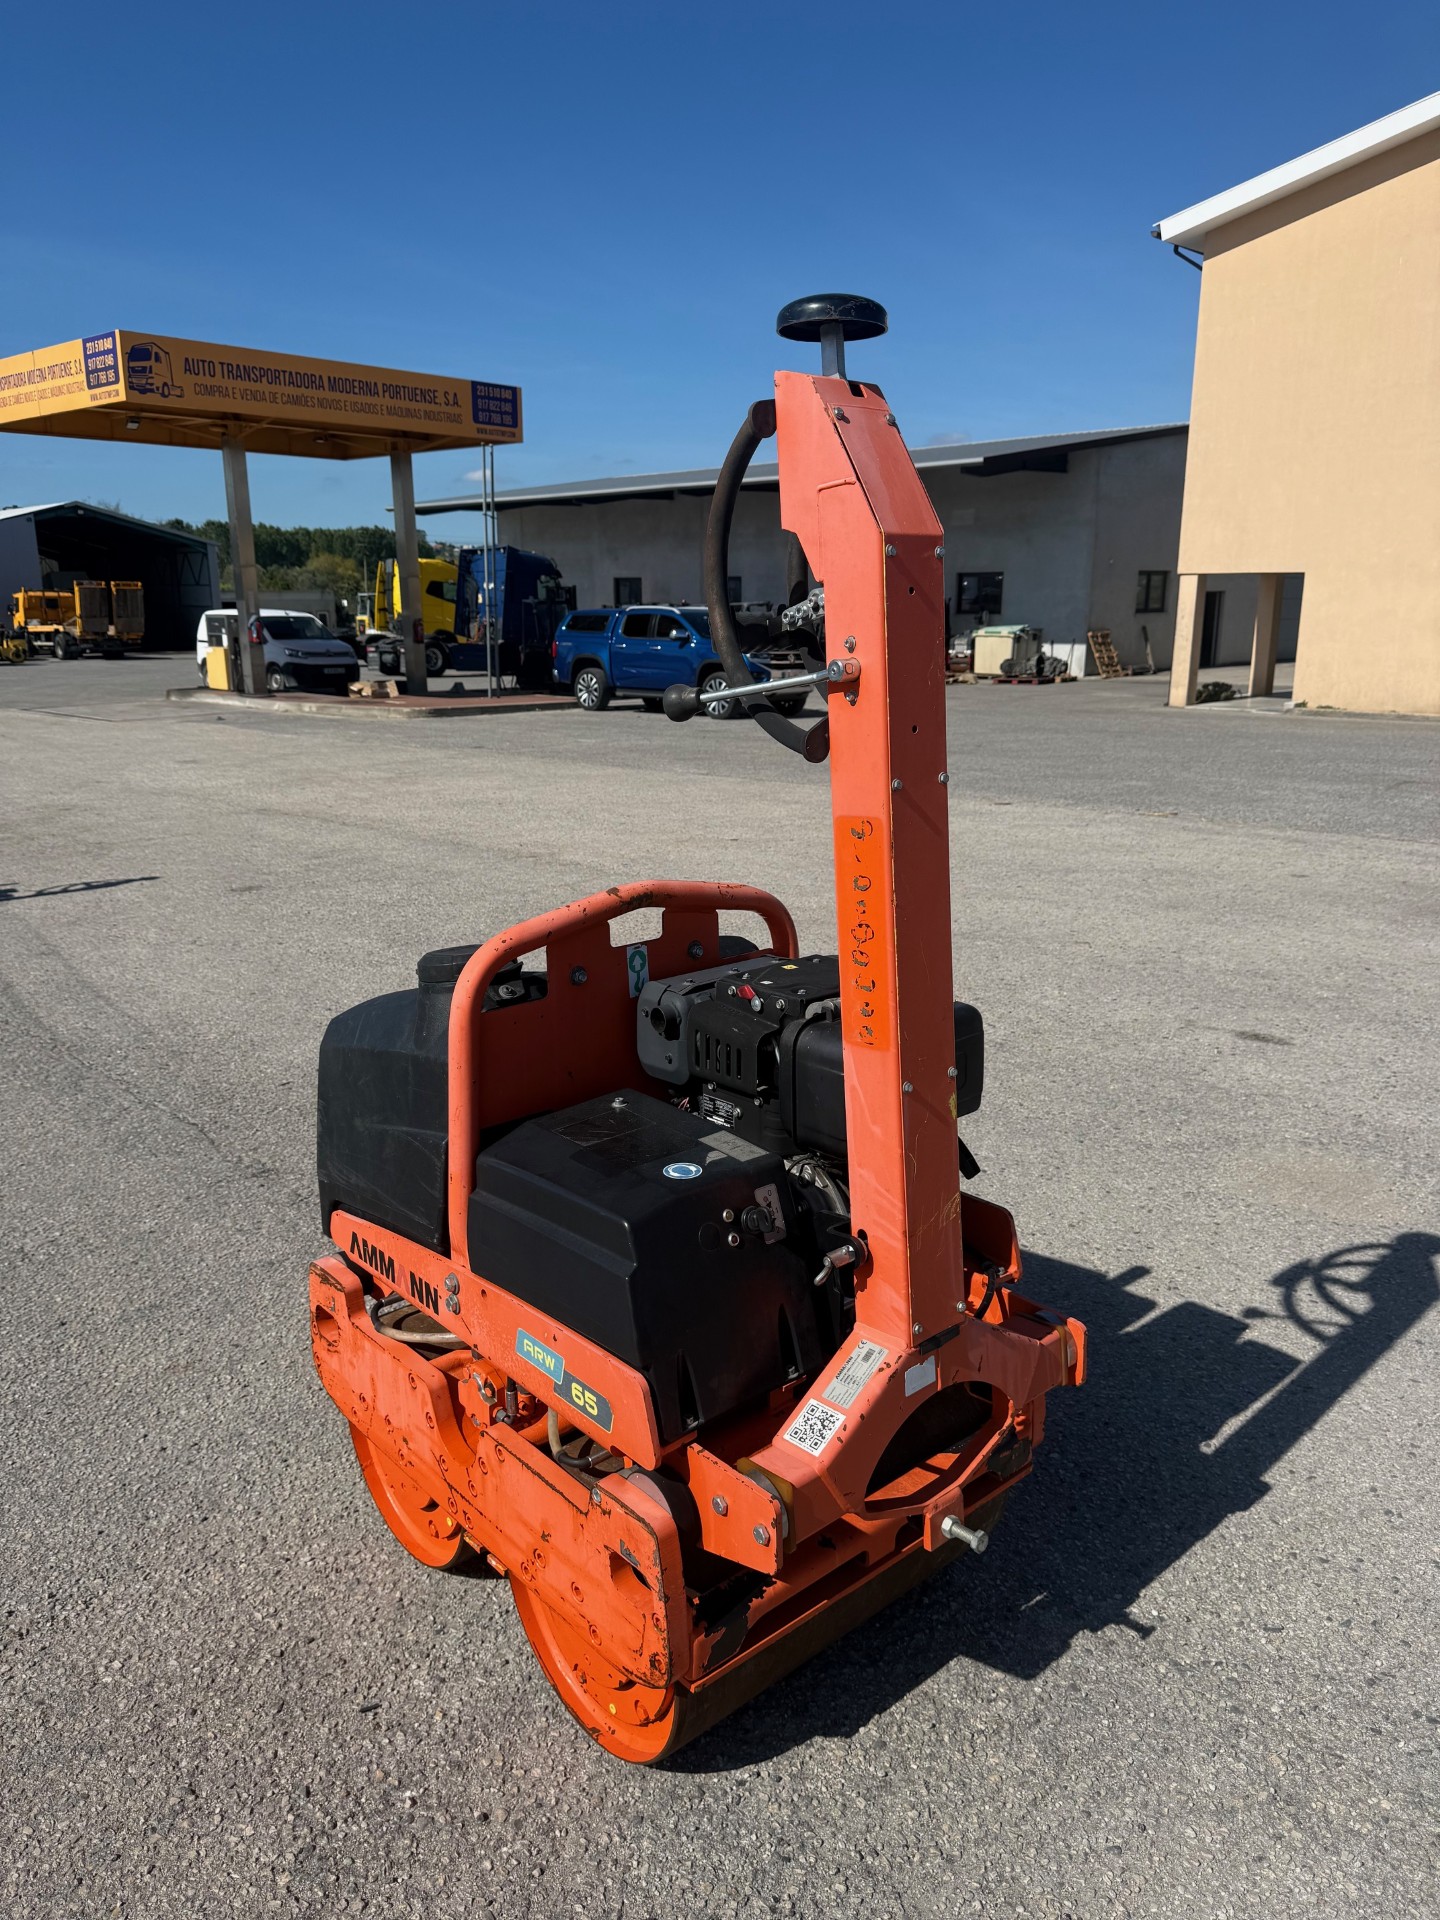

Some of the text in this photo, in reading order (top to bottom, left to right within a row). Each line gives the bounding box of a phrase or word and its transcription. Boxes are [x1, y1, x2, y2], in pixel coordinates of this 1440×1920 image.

[184, 357, 462, 408] AUTO TRANSPORTADORA MODERNA PORTUENSE, S.A.
[476, 384, 488, 397] 231
[194, 382, 231, 399] COMPRA
[232, 387, 238, 400] E
[239, 388, 267, 403] VENDA
[269, 391, 280, 404] DE
[281, 391, 316, 408] CAMIÕES
[317, 397, 342, 411] NOVOS
[344, 400, 349, 412] E
[350, 401, 379, 416] USADOS
[380, 404, 385, 416] E
[423, 408, 463, 425] INDUSTRIAIS
[477, 398, 488, 410] 917
[478, 411, 489, 422] 917
[349, 1231, 440, 1316] AMMANN
[523, 1338, 556, 1372] ARW
[835, 1355, 854, 1380] AMMANN
[571, 1382, 599, 1417] 65
